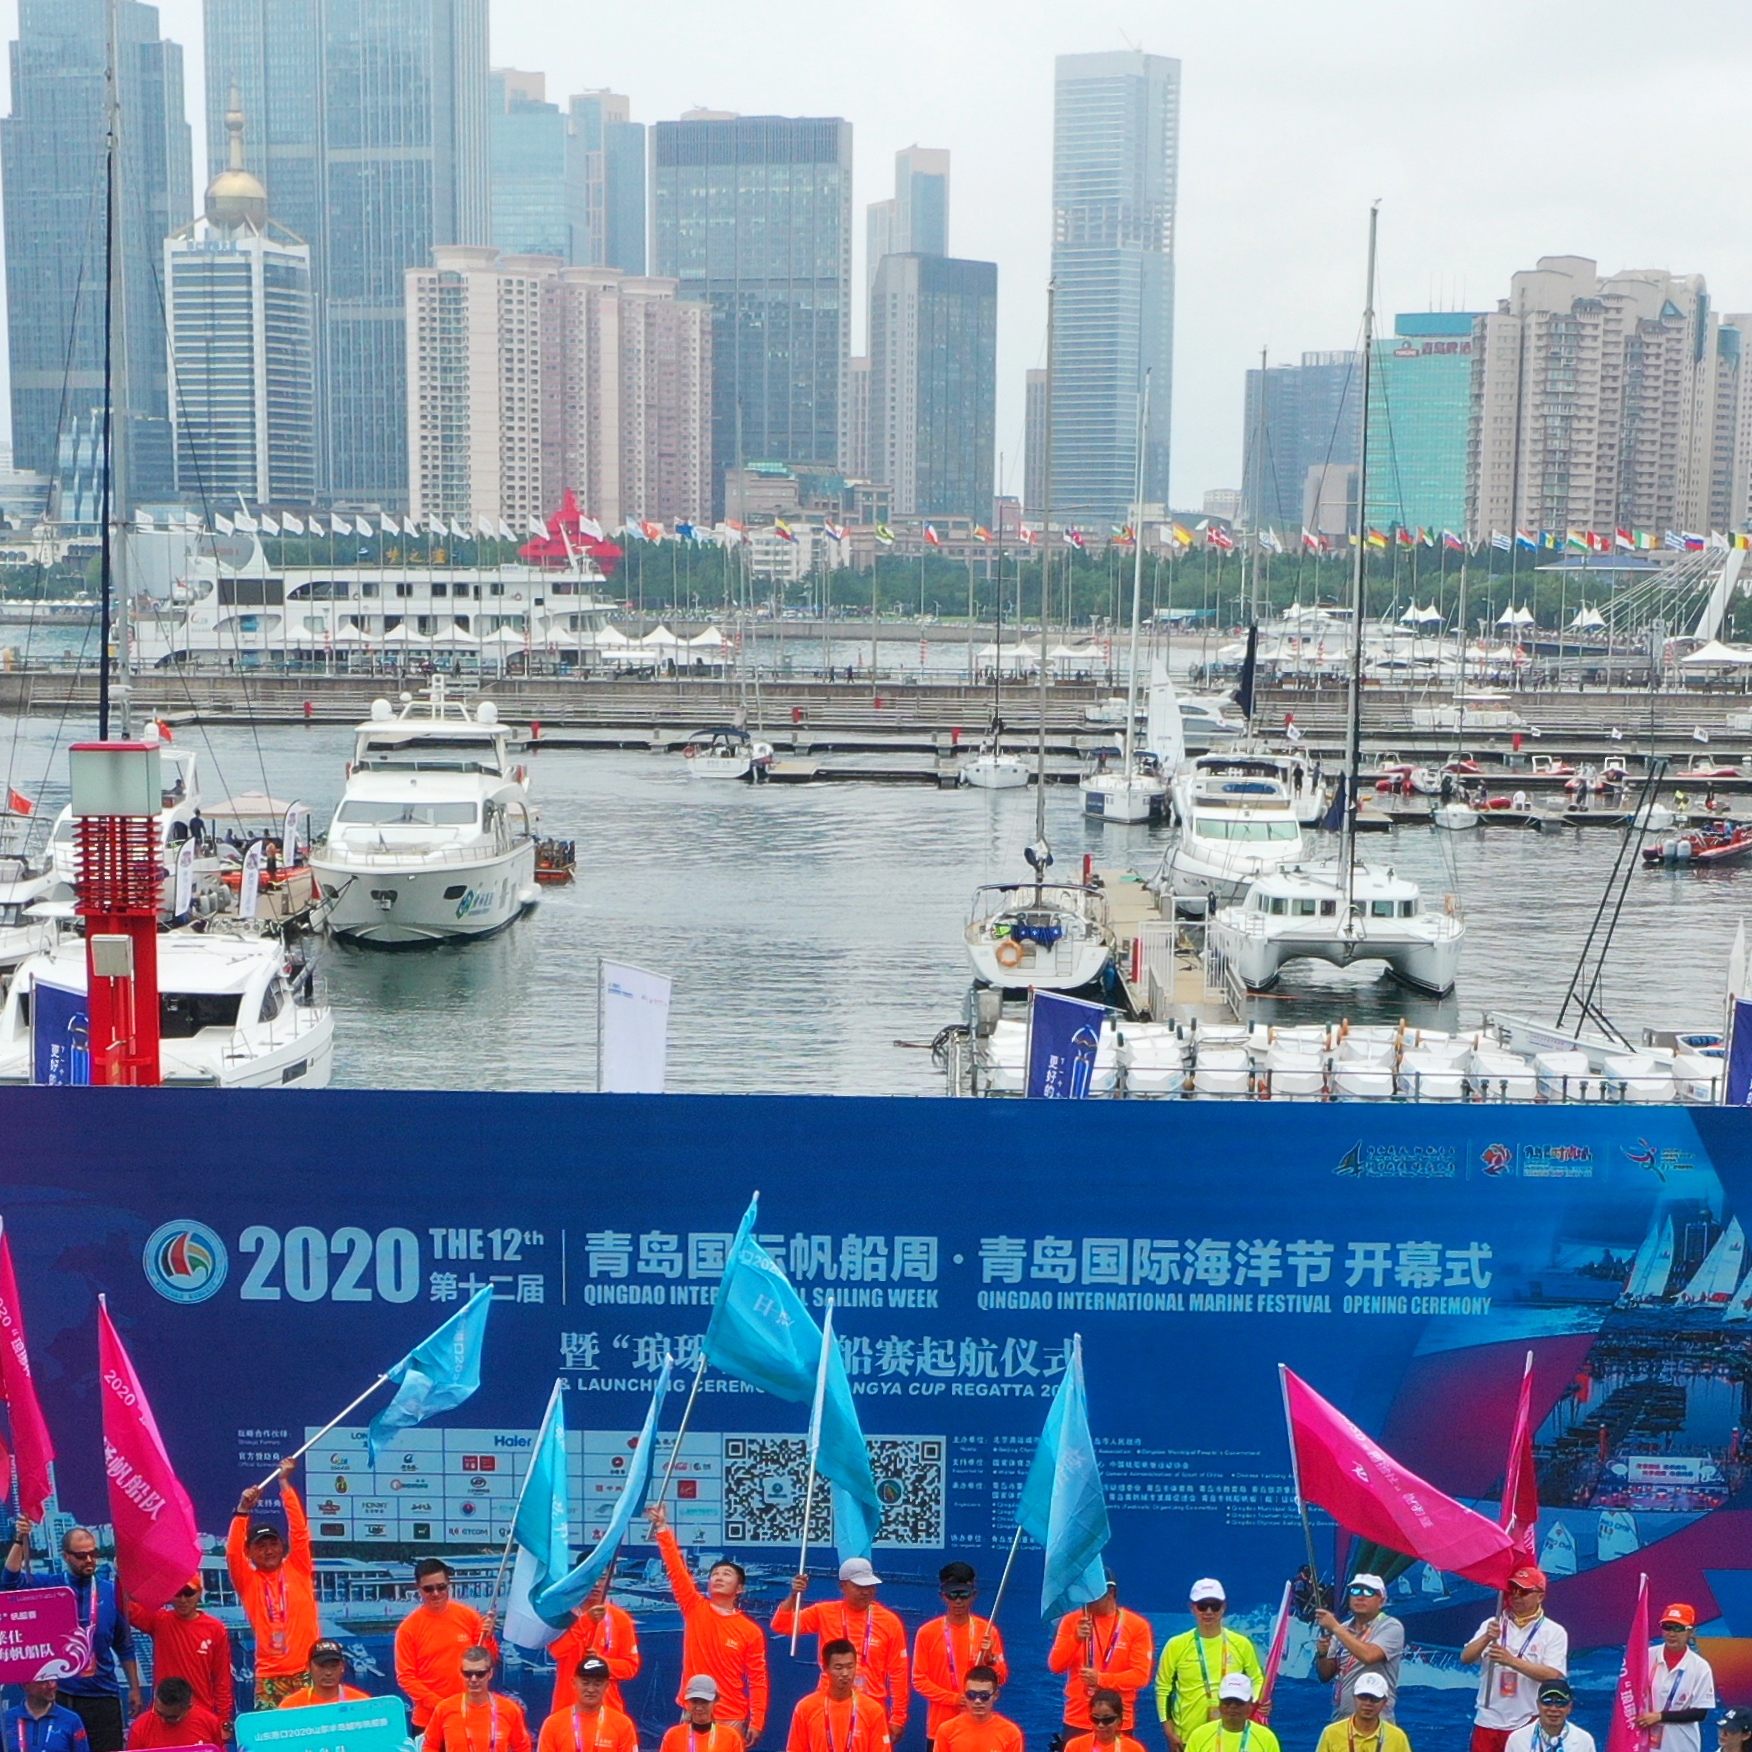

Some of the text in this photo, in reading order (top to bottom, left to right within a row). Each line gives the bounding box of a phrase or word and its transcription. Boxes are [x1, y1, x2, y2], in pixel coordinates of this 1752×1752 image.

[429, 1229, 545, 1262] THE 12th
[239, 1227, 420, 1304] 2020
[1345, 1239, 1494, 1290] 开幕式
[429, 1272, 545, 1304] 第十二届
[583, 1285, 665, 1307] QINGDAO
[887, 1288, 940, 1309] WEEK
[977, 1290, 1493, 1316] QINGDAO INTERNATIONAL MARINE FESTIVAL OPENING CEREMONY
[907, 1382, 947, 1397] CUP
[950, 1382, 1038, 1398] REGATTA
[493, 1435, 532, 1448] Haier
